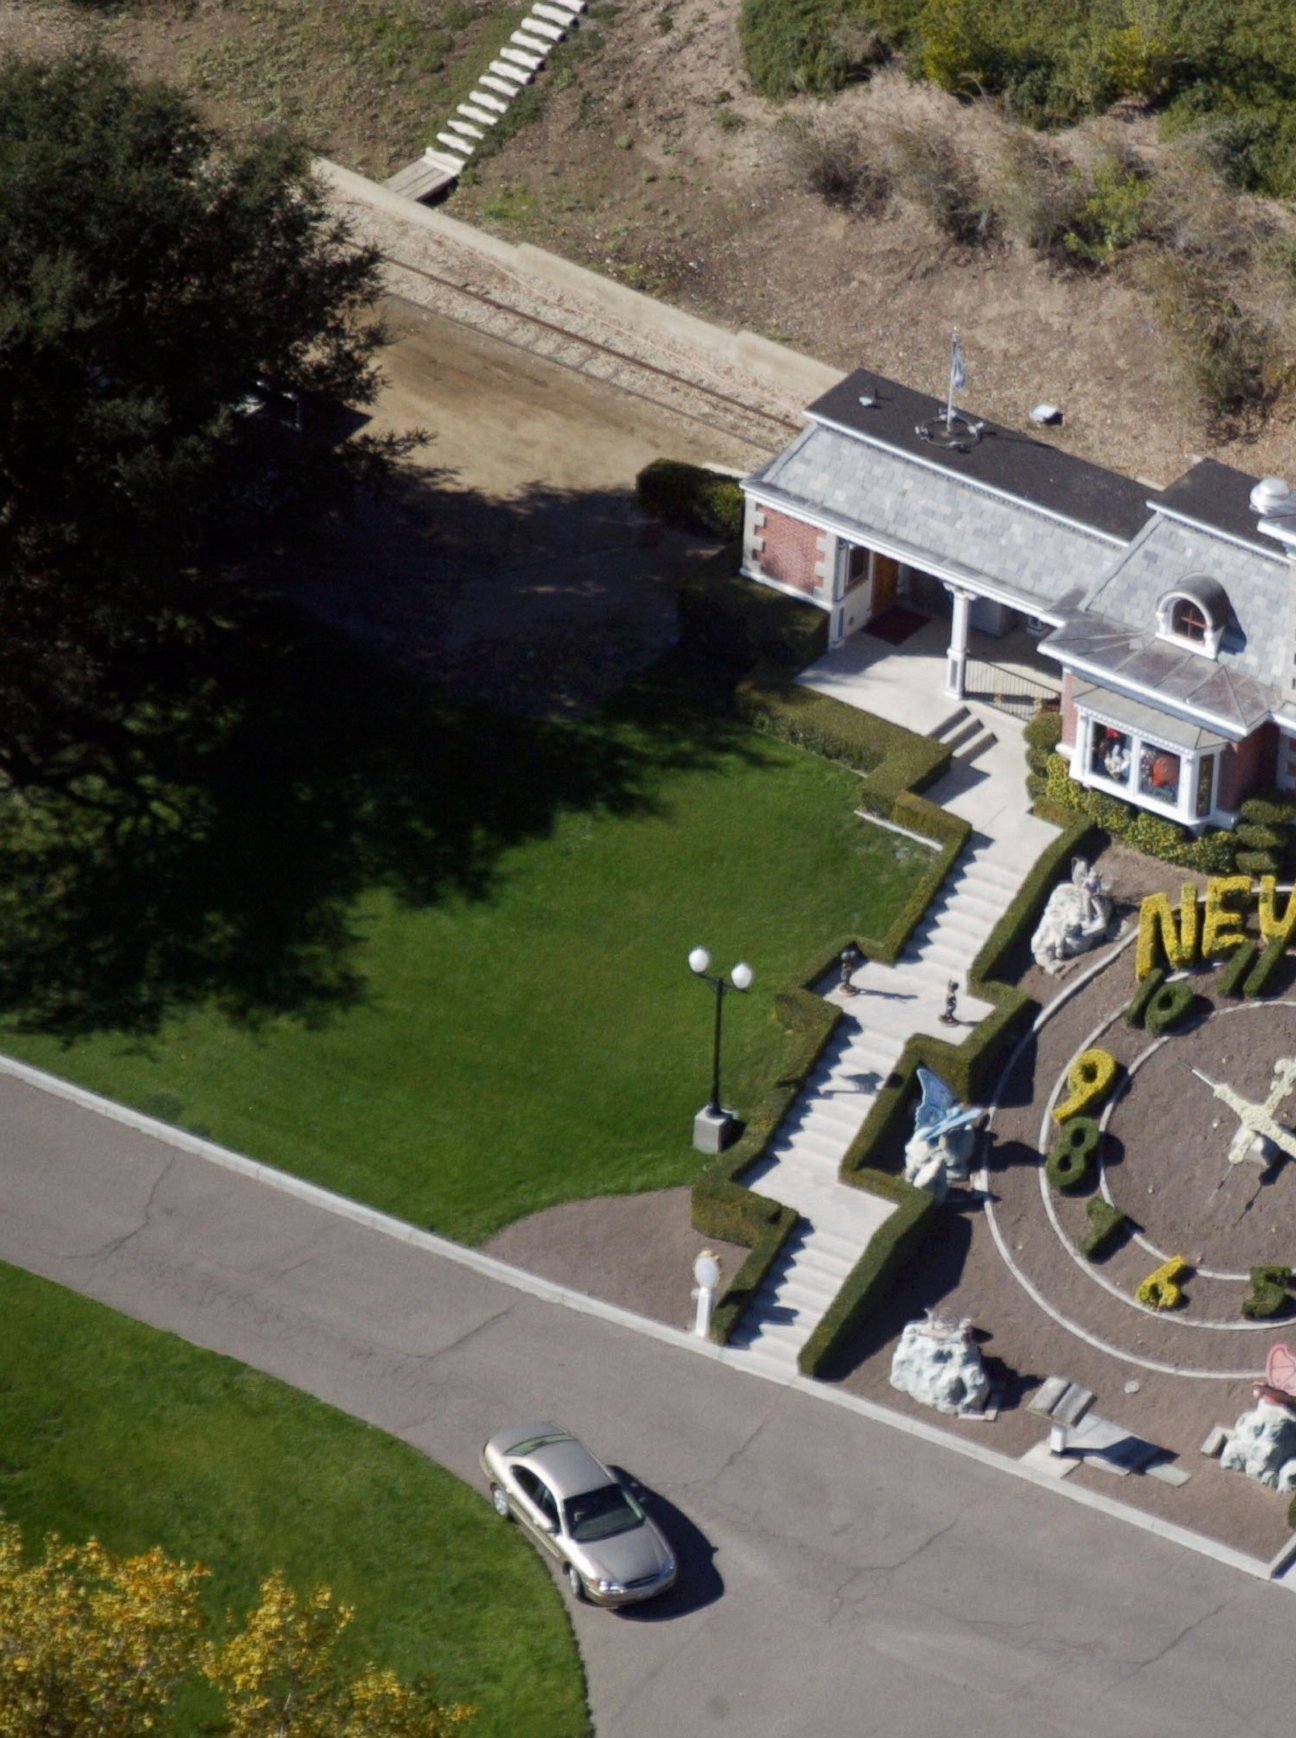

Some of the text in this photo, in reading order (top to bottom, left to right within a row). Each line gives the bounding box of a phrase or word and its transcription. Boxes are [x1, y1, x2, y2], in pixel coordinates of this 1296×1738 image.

[1126, 968, 1194, 1036] 10
[1053, 1049, 1117, 1124] 9
[1046, 1116, 1100, 1190] 8
[1080, 1196, 1124, 1260] 7
[1136, 1254, 1187, 1310] 6
[1242, 1265, 1292, 1319] 5
